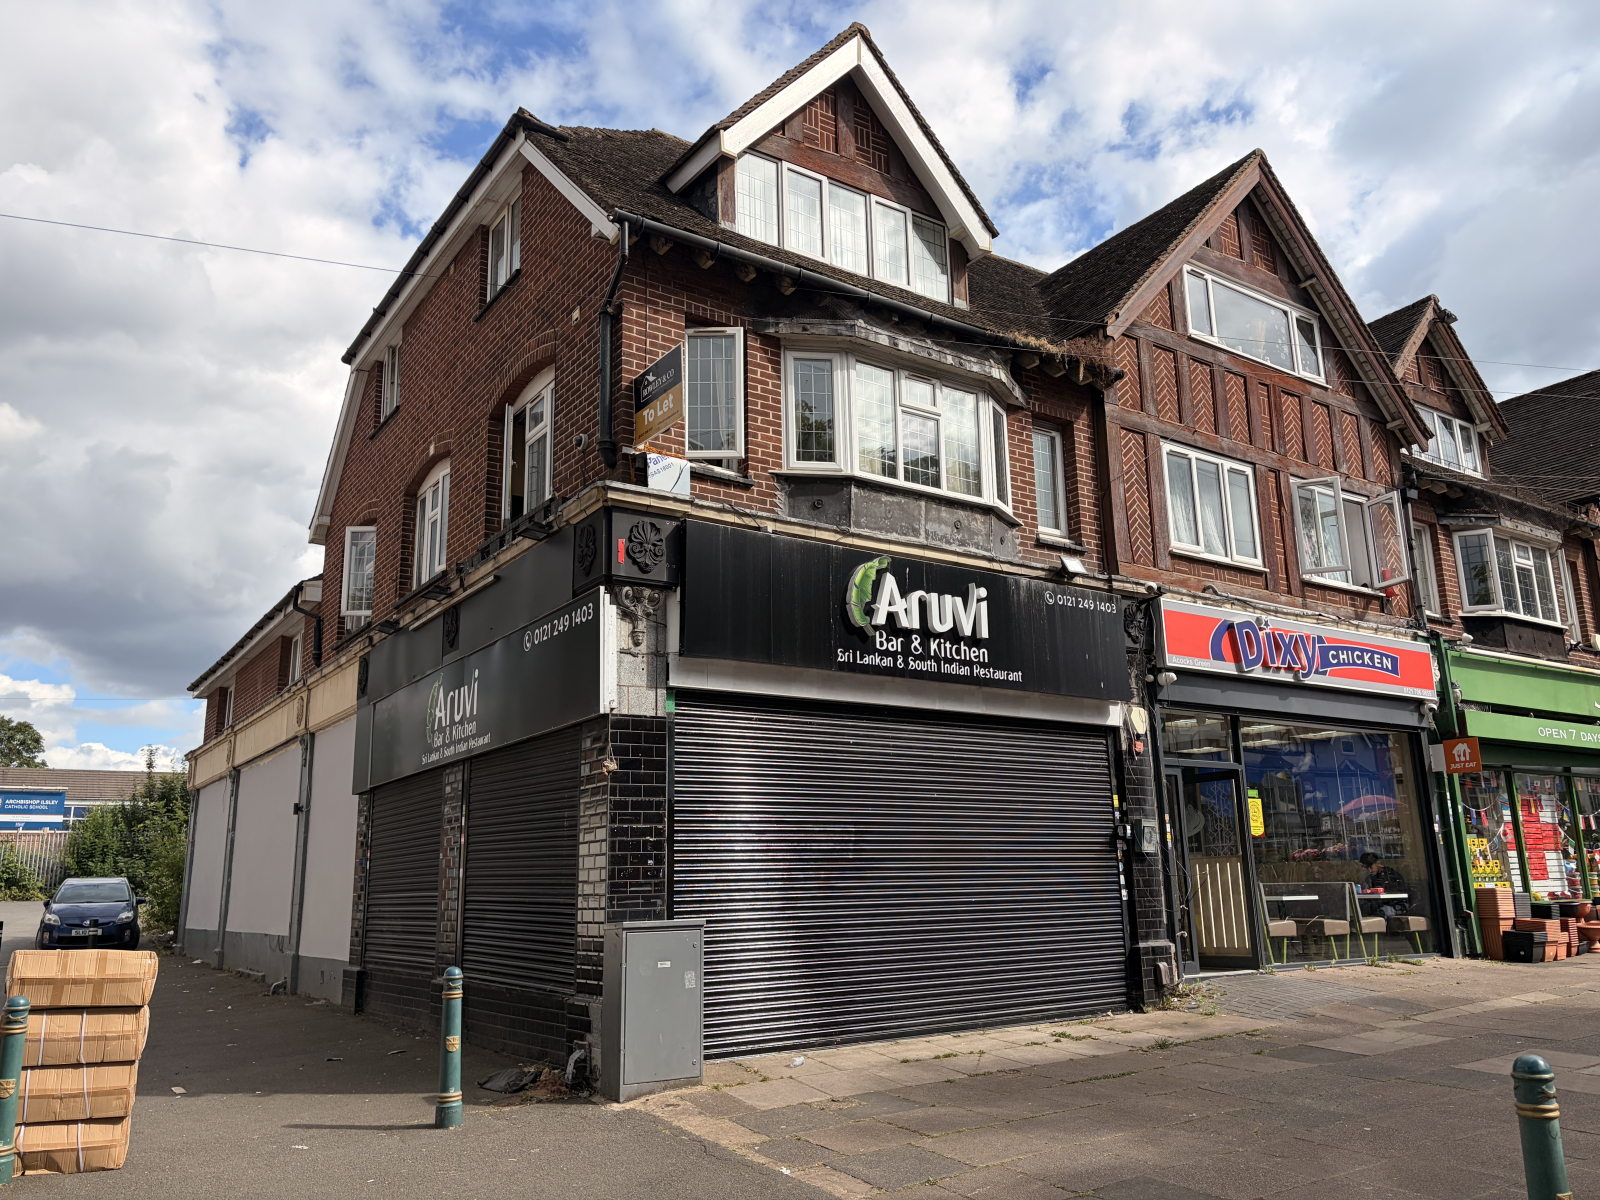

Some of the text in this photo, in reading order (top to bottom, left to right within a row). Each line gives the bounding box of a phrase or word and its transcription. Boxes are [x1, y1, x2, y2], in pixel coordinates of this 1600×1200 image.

[643, 408, 654, 425] To
[656, 393, 674, 417] Let
[646, 455, 670, 469] Pane
[871, 572, 989, 639] Aruvi
[1057, 594, 1117, 613] 0121 249 1403
[534, 602, 593, 644] 0121 249 1403
[875, 630, 989, 662] Bar & Kitchen
[1172, 656, 1211, 668] Acocks Green
[1234, 615, 1392, 680] Dixy CHICKEN
[837, 648, 1023, 682] Sri Lankan & South Indian Restaurant
[434, 668, 479, 730] Aruvi
[433, 731, 444, 748] Bar
[452, 721, 477, 741] Kitchen
[468, 732, 491, 749] Restaurant
[1538, 726, 1567, 739] OPEN
[1568, 729, 1577, 740] 7
